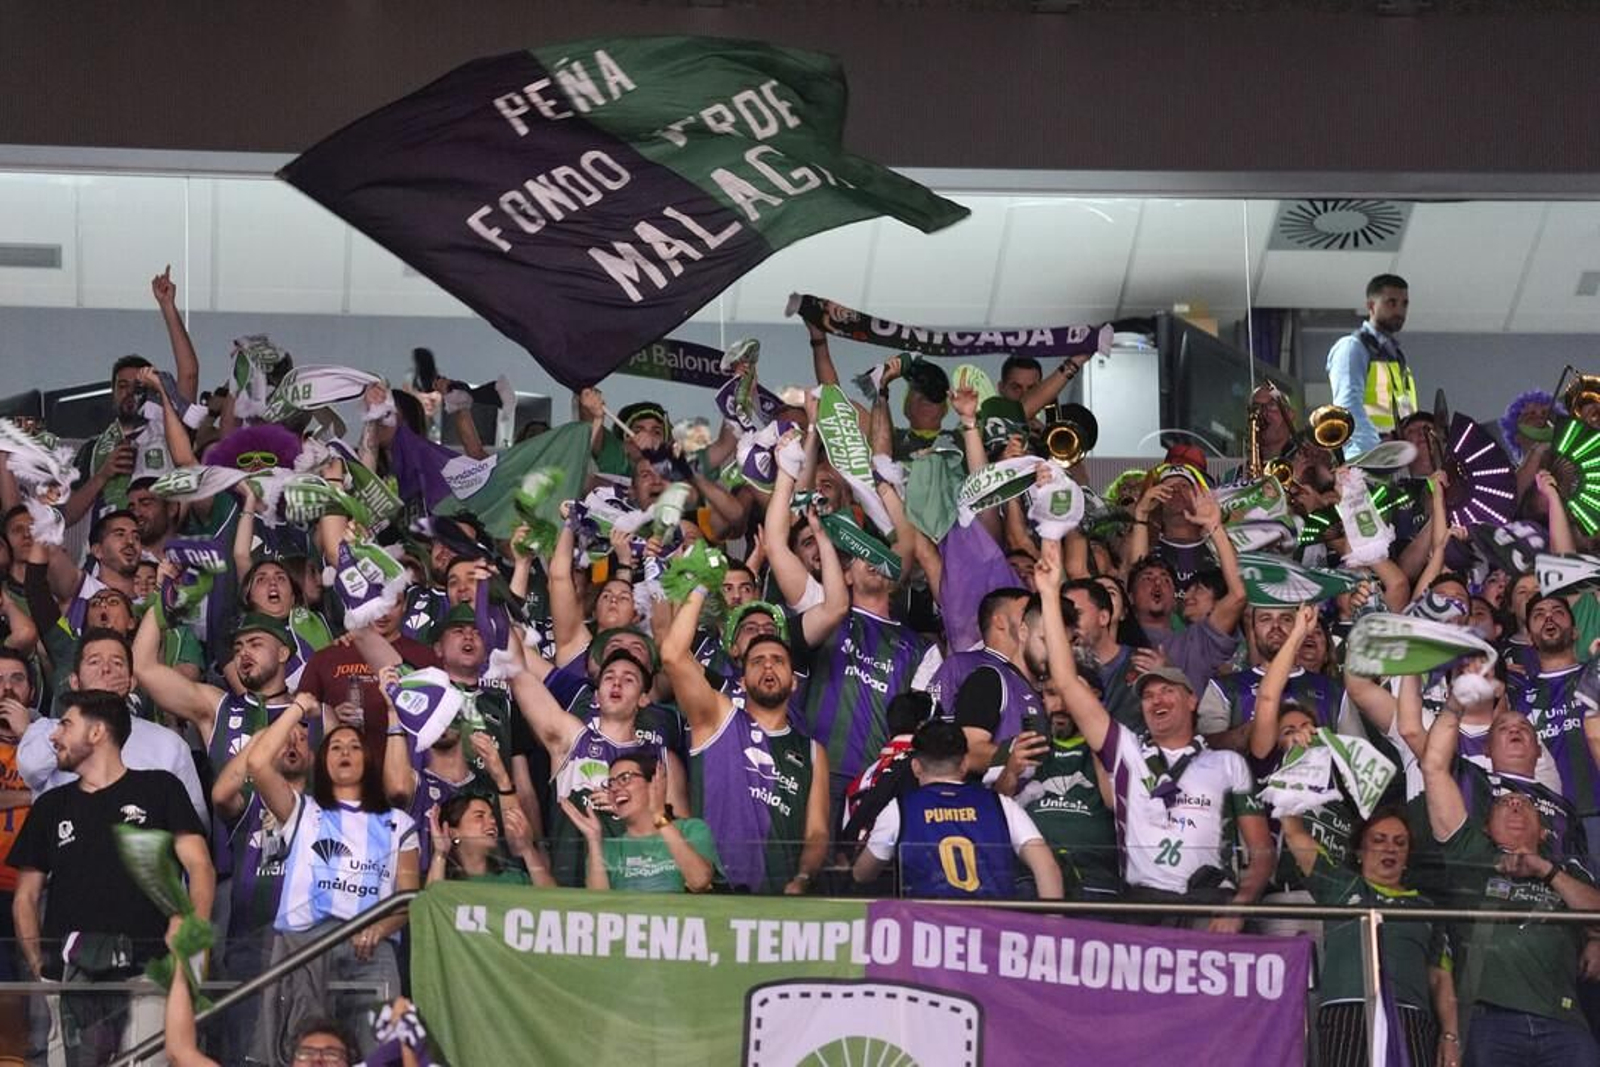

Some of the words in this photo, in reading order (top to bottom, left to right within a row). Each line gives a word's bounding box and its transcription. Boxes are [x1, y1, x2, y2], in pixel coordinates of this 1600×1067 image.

[494, 50, 638, 136] PEÑA
[466, 150, 631, 252] FONDO
[924, 807, 977, 824] PUNTER
[1040, 796, 1089, 812] Unicaja
[939, 836, 980, 892] 0
[1154, 838, 1184, 867] 26
[503, 907, 719, 967] CARPENA,
[730, 918, 901, 965] TEMPLO
[912, 920, 988, 974] DEL
[999, 930, 1286, 1000] BALONCESTO
